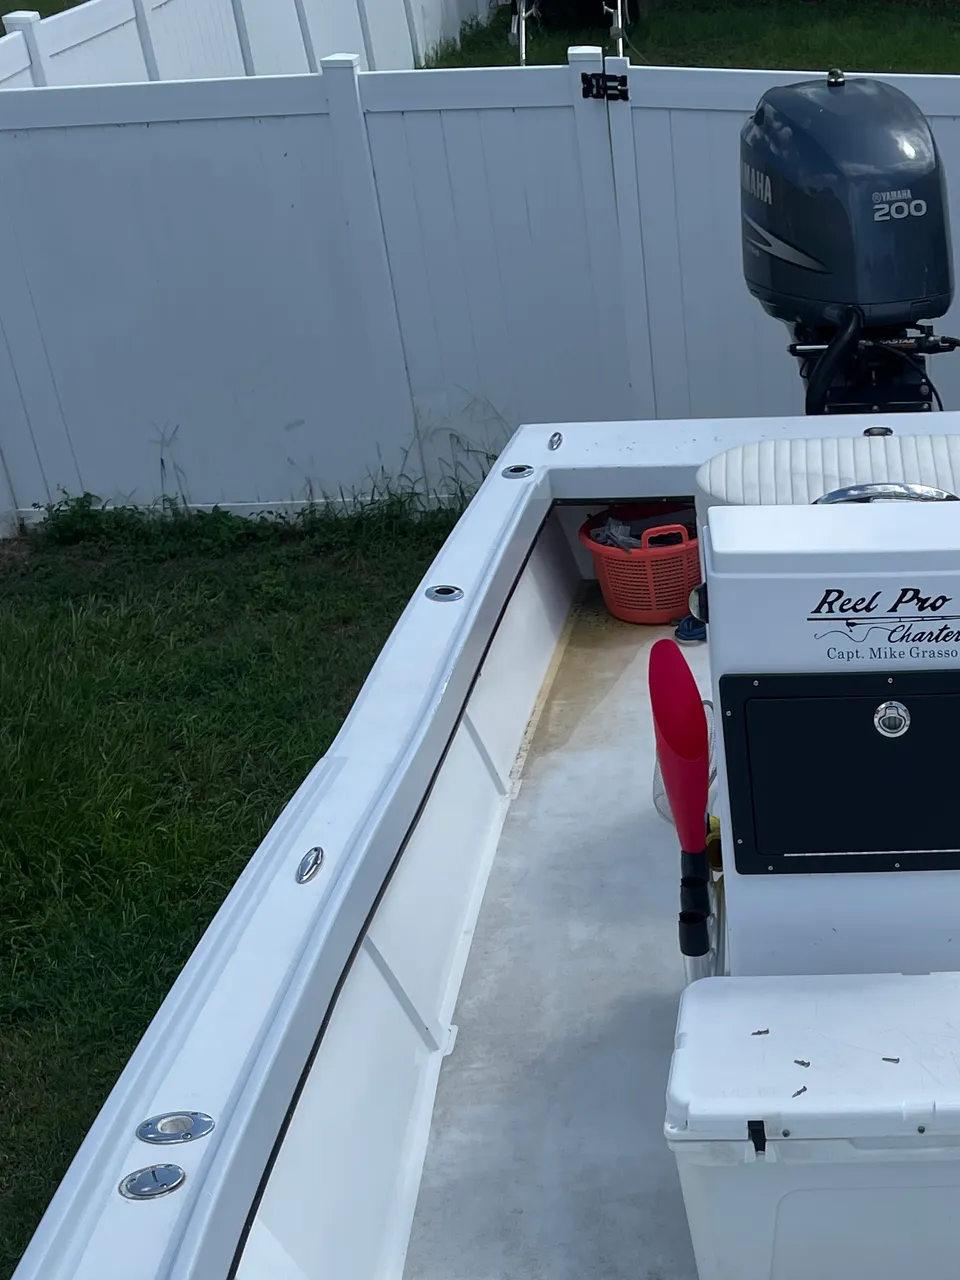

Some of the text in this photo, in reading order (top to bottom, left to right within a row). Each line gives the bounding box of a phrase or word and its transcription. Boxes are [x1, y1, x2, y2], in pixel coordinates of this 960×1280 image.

[742, 162, 772, 205] MAHA
[881, 189, 912, 201] YAMAHA
[873, 200, 927, 221] 200
[810, 587, 952, 614] Reel Pro
[826, 646, 958, 662] Capt. Mike Grasso
